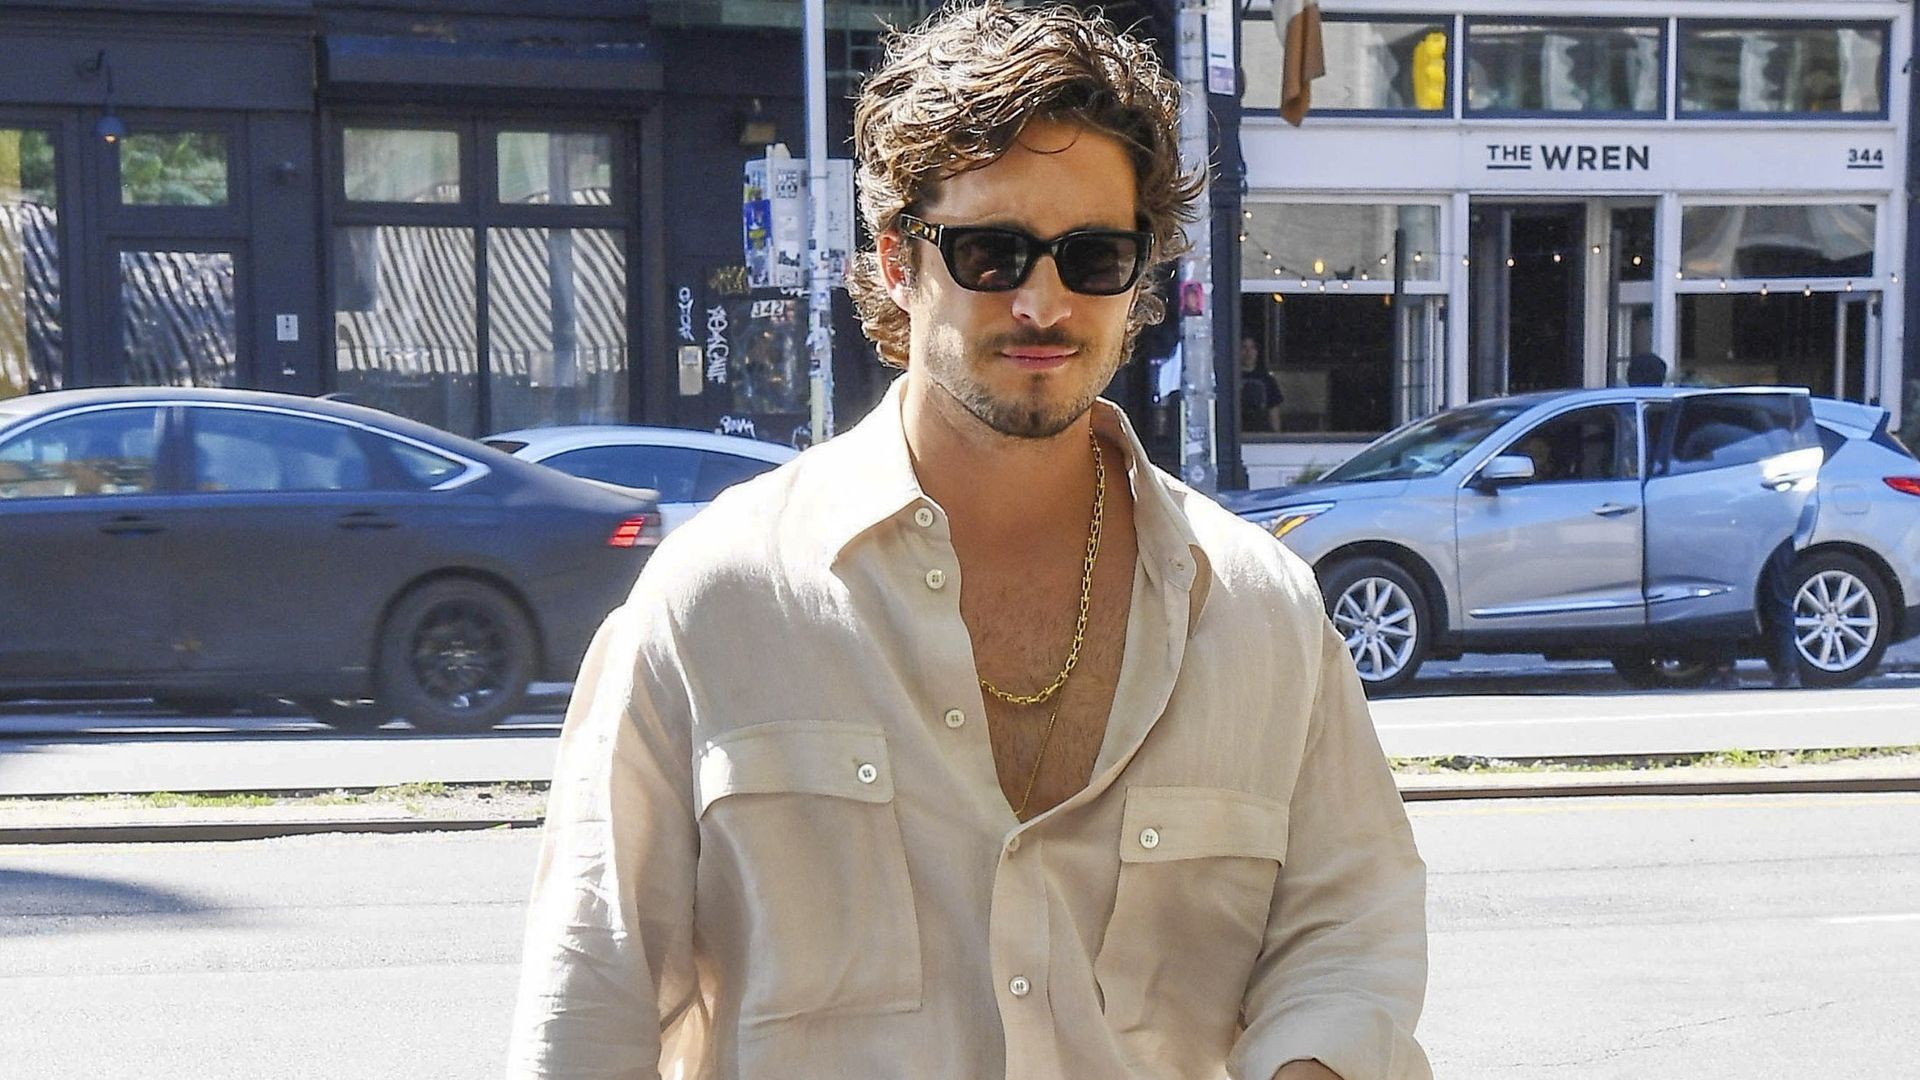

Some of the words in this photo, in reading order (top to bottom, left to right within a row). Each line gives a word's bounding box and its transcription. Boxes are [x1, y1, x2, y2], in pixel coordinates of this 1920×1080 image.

[1486, 144, 1532, 161] THE
[1540, 145, 1649, 171] WREN
[1848, 148, 1884, 163] 344
